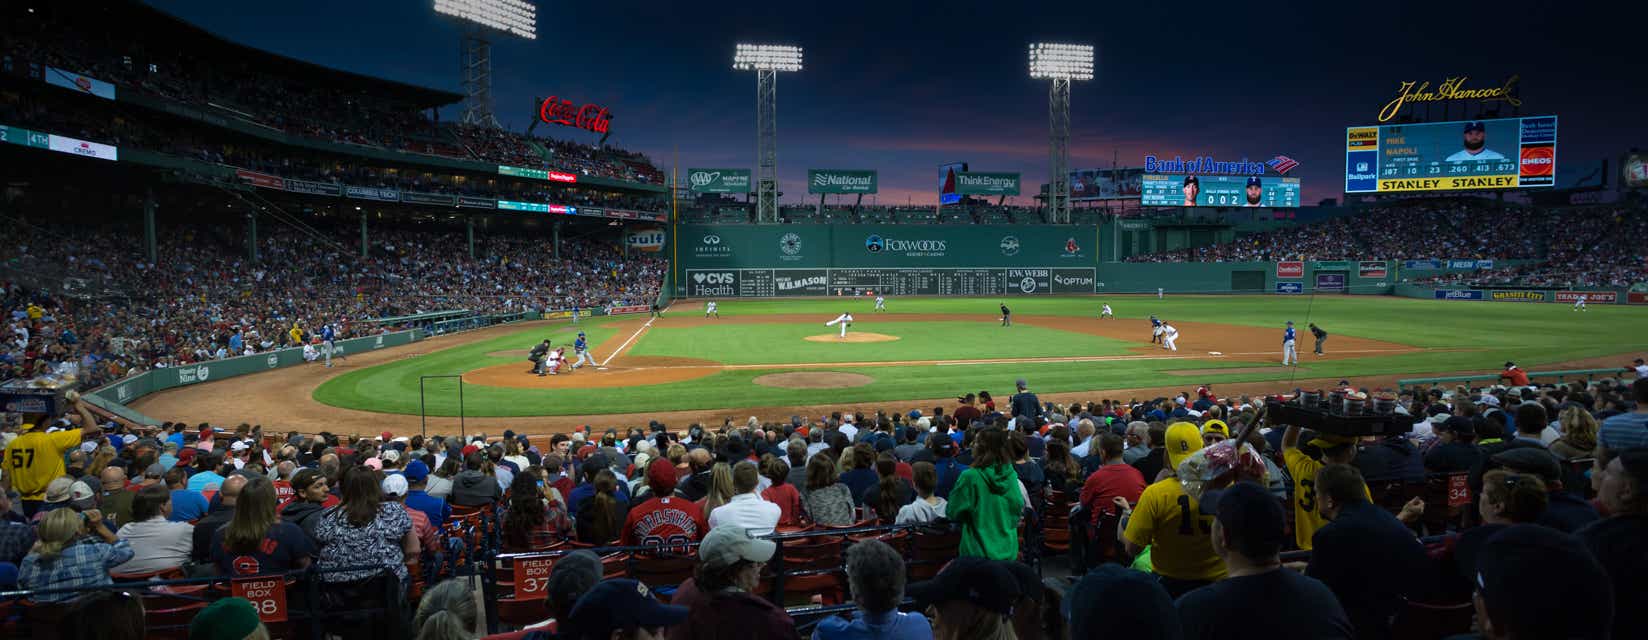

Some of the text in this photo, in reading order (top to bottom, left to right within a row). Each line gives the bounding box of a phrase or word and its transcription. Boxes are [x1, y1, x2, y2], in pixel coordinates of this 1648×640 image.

[1378, 74, 1522, 122] John Hancock
[540, 96, 608, 134] Coca-Cola
[1386, 147, 1417, 156] NAPOLI
[1145, 156, 1264, 174] Bank of America
[1522, 157, 1552, 165] ENEOS
[827, 175, 872, 185] National
[1382, 179, 1440, 189] STANLEY
[1451, 176, 1513, 187] STANLEY
[1208, 195, 1238, 204] 0 0 2
[627, 232, 662, 244] Gulf
[884, 238, 946, 252] FOXWOODS
[706, 272, 734, 284] CVS
[1063, 277, 1093, 286] OPTUM
[695, 284, 734, 296] Health
[11, 447, 35, 469] 57
[1449, 488, 1467, 500] 34
[522, 559, 552, 568] FIELD
[525, 567, 548, 576] BOX
[241, 580, 276, 590] FIELD
[522, 577, 550, 592] 37
[247, 589, 272, 598] BOX
